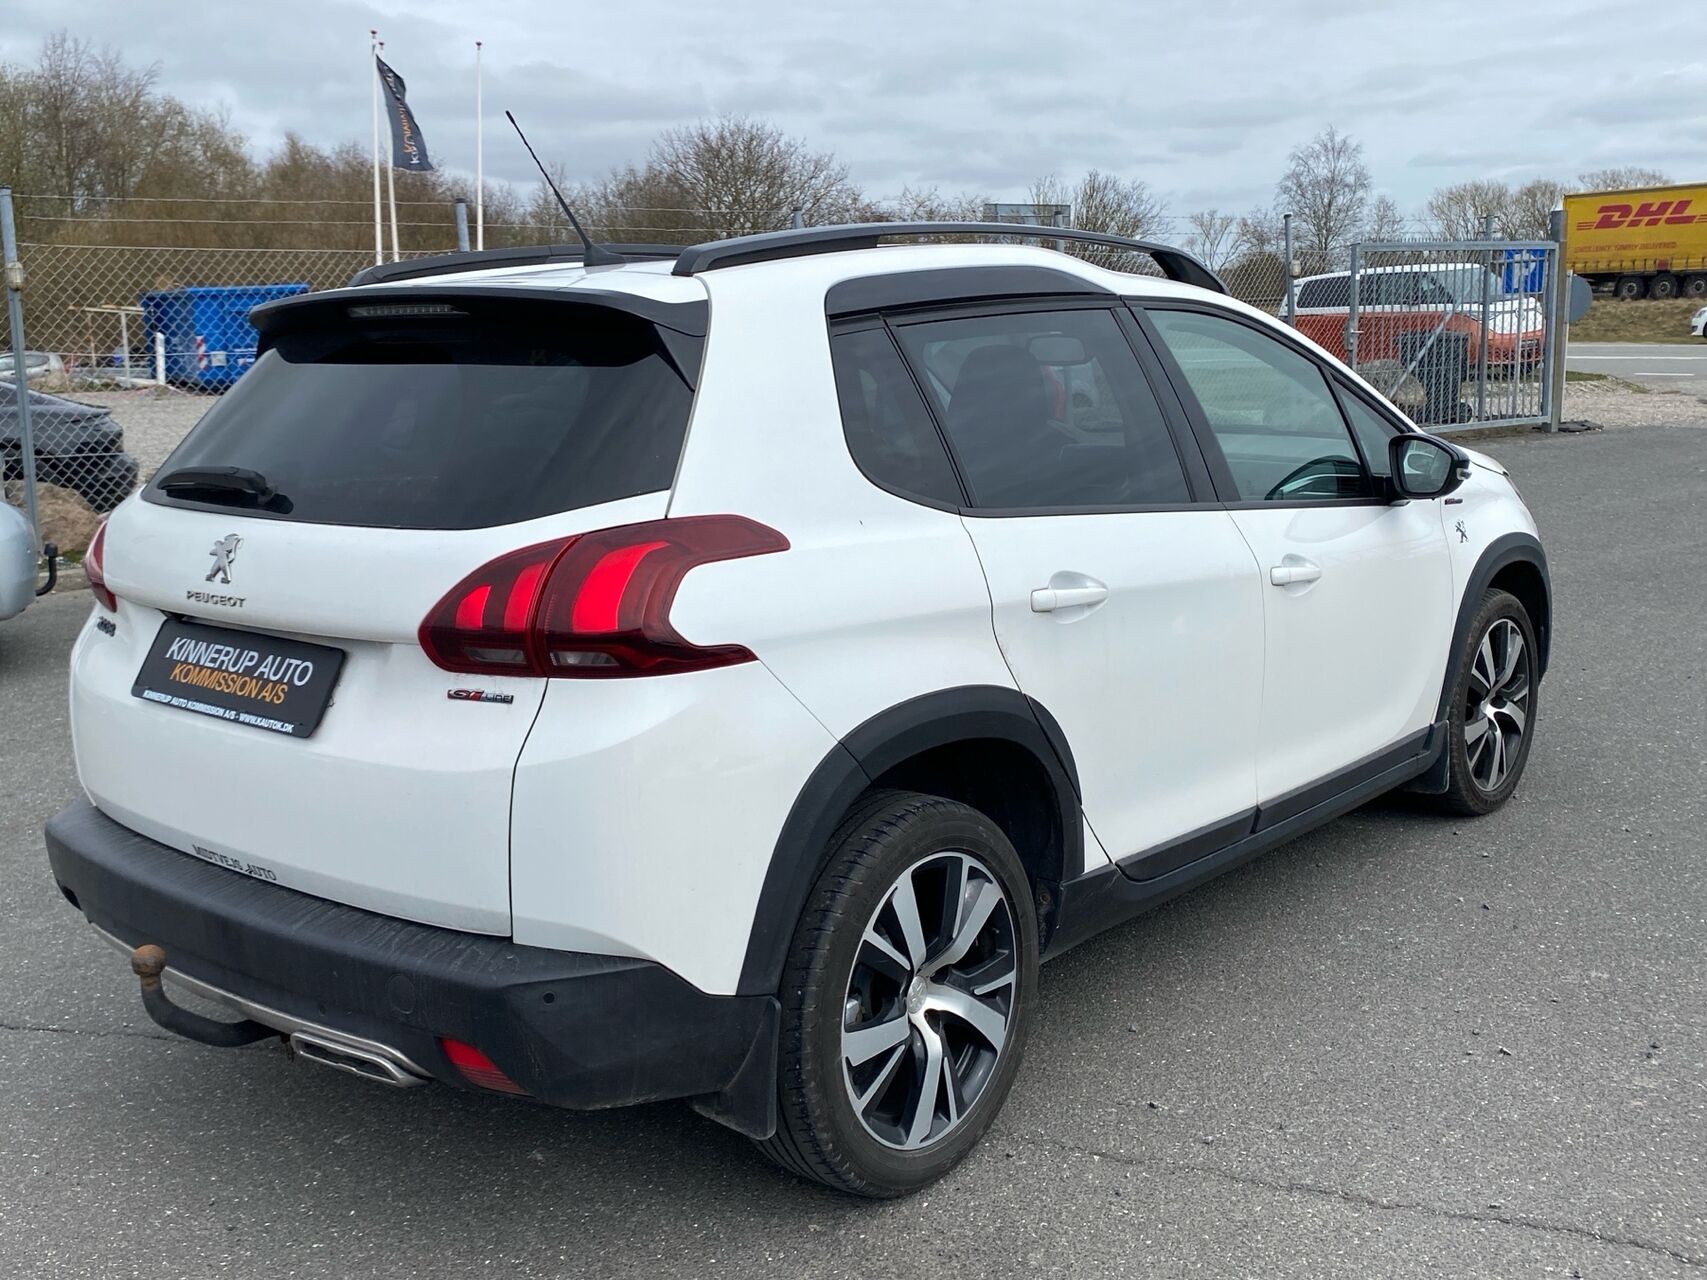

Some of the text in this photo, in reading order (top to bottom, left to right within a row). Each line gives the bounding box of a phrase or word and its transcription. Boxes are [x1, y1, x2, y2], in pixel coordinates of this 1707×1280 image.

[1594, 200, 1697, 229] DHL
[186, 590, 246, 608] PEUGEOT
[166, 637, 313, 686] KINNERUP AUTO
[170, 663, 288, 704] KOMMISSION A/S
[244, 863, 277, 881] AUTO
